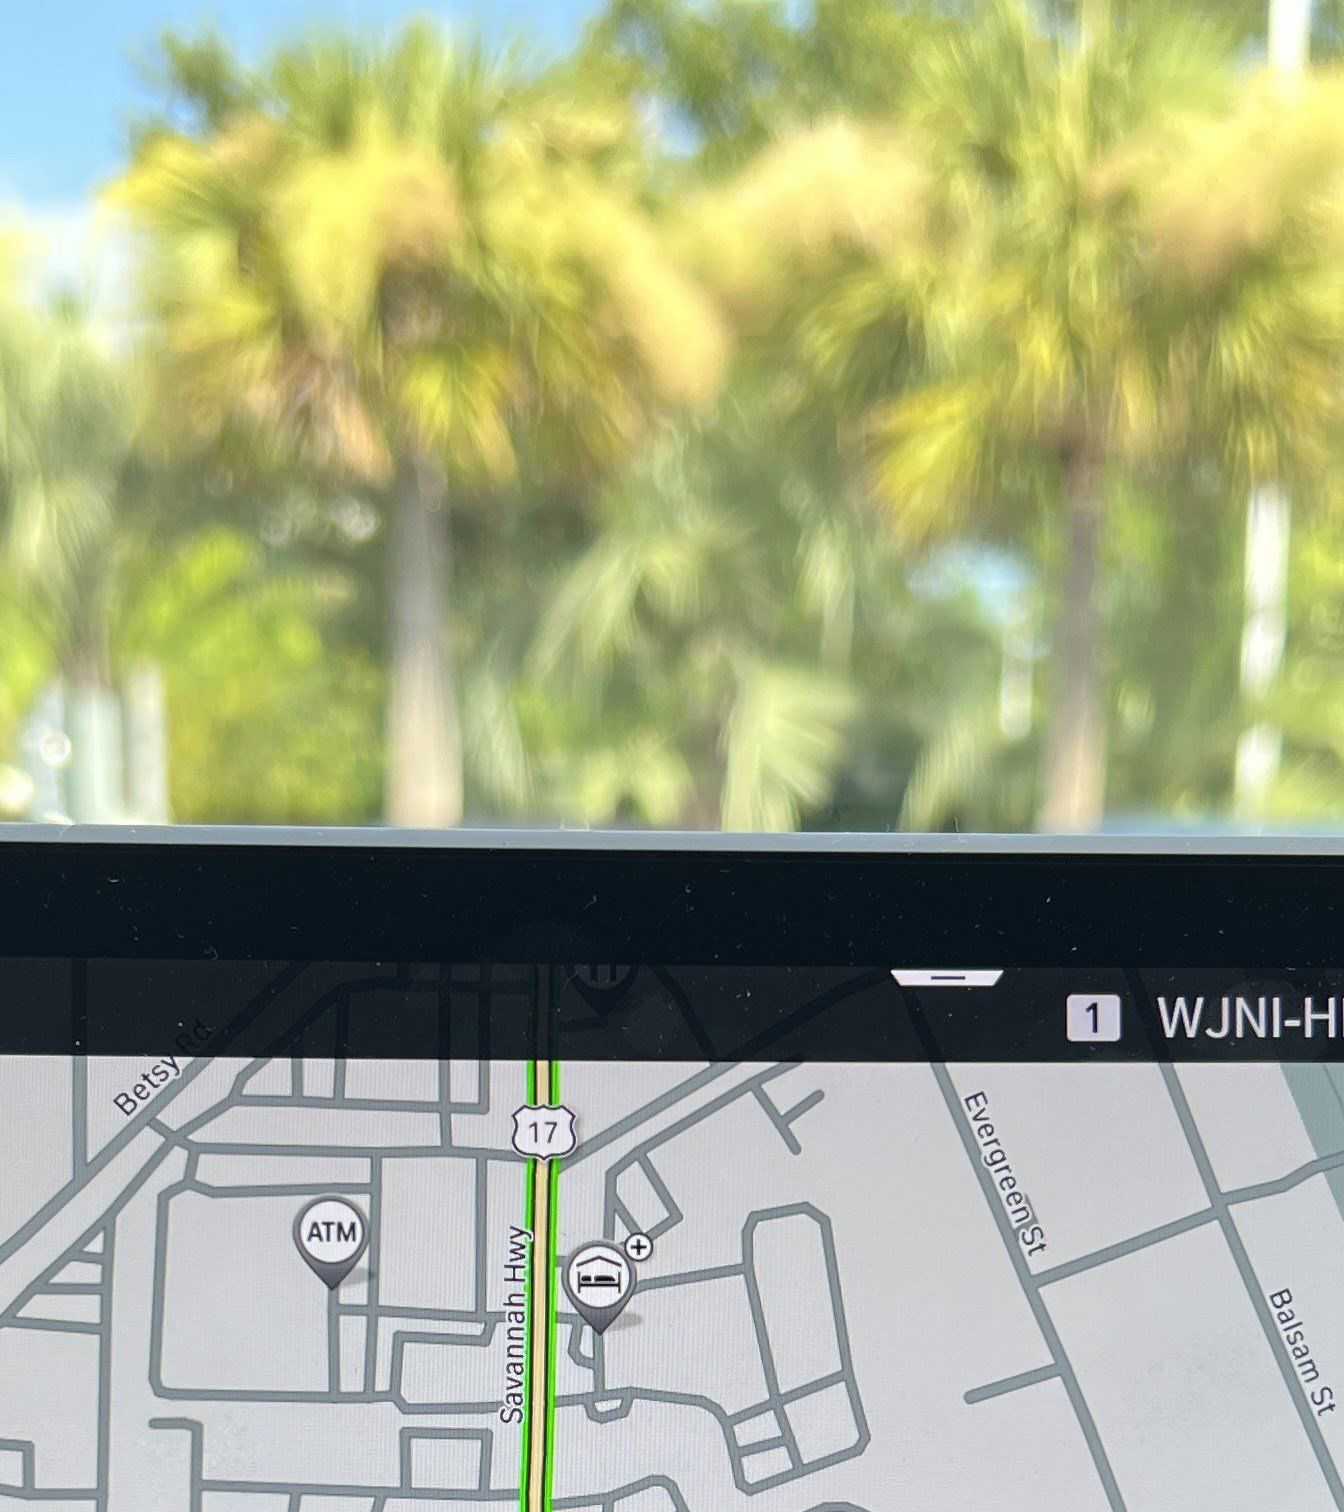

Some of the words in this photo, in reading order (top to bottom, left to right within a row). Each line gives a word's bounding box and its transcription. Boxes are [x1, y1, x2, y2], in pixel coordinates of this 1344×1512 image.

[113, 1055, 181, 1116] Betsy
[528, 1121, 558, 1144] 17
[964, 1090, 1031, 1224] Evergreen
[1021, 1225, 1048, 1258] St
[306, 1221, 357, 1244] ATM
[503, 1224, 533, 1283] Hwy
[499, 1291, 526, 1425] Savannah
[1269, 1287, 1320, 1383] Balsam
[1310, 1385, 1337, 1418] St
